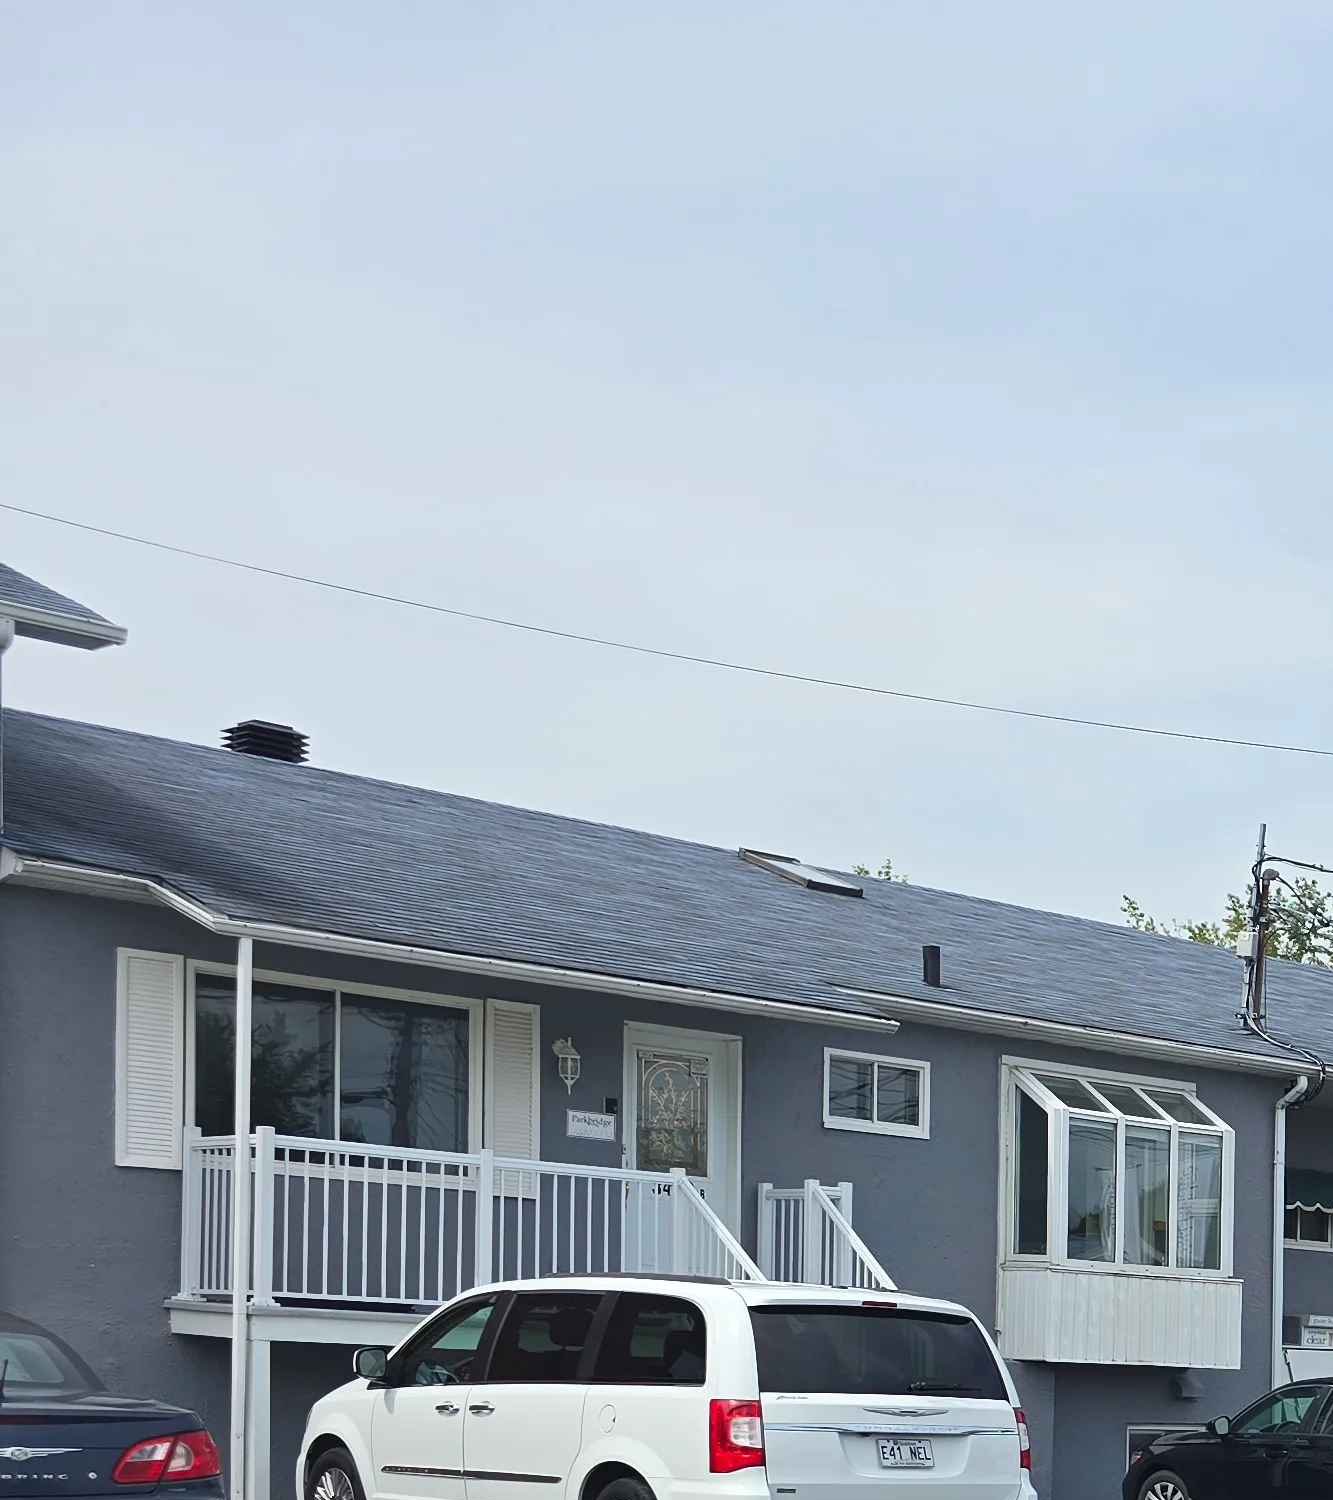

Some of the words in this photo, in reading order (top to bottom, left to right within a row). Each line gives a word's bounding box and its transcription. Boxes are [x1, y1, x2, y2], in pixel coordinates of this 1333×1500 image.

[571, 1114, 612, 1128] Parkbridge
[1306, 1336, 1326, 1345] clear
[881, 1445, 903, 1460] E41
[909, 1446, 931, 1460] NEL
